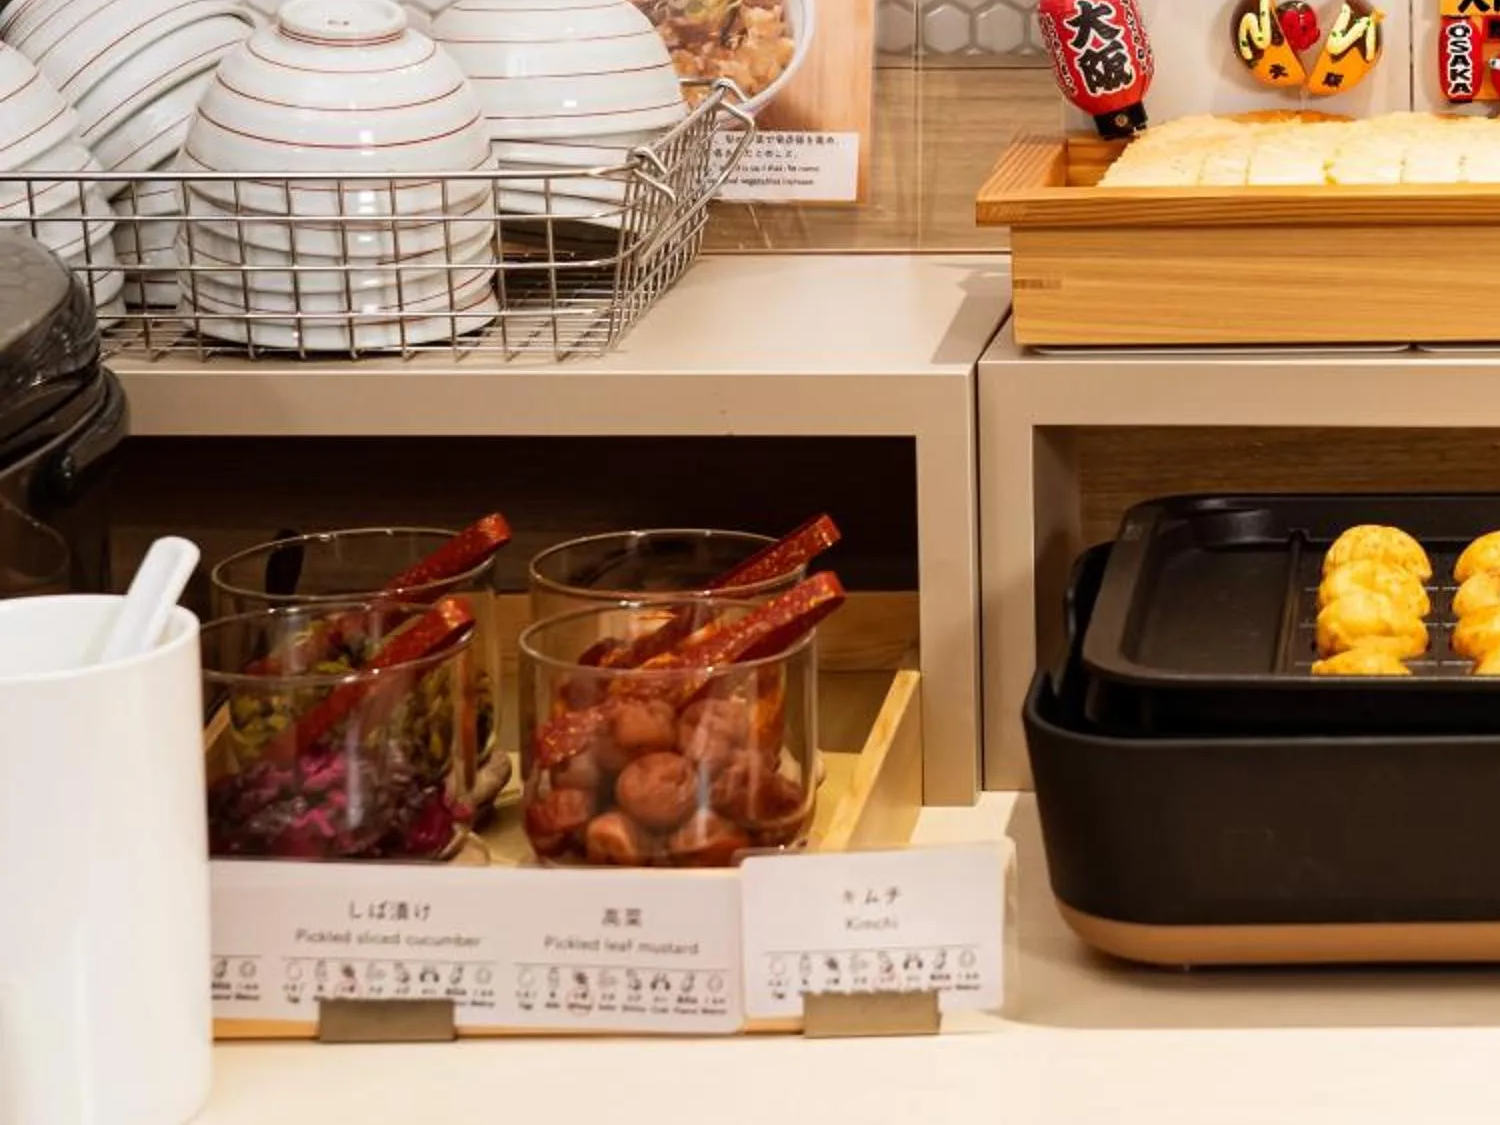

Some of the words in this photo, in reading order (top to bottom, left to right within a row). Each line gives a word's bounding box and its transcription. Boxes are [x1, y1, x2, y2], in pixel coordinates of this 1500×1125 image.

[1447, 25, 1472, 95] OSAKA
[843, 886, 902, 905] キムチ
[348, 899, 431, 922] しば漬け
[601, 908, 644, 928] 高菜
[295, 930, 352, 945] Pickled
[357, 931, 401, 946] sliced
[406, 933, 482, 948] cucumber
[544, 935, 600, 952] Pickled
[638, 940, 700, 956] mustard
